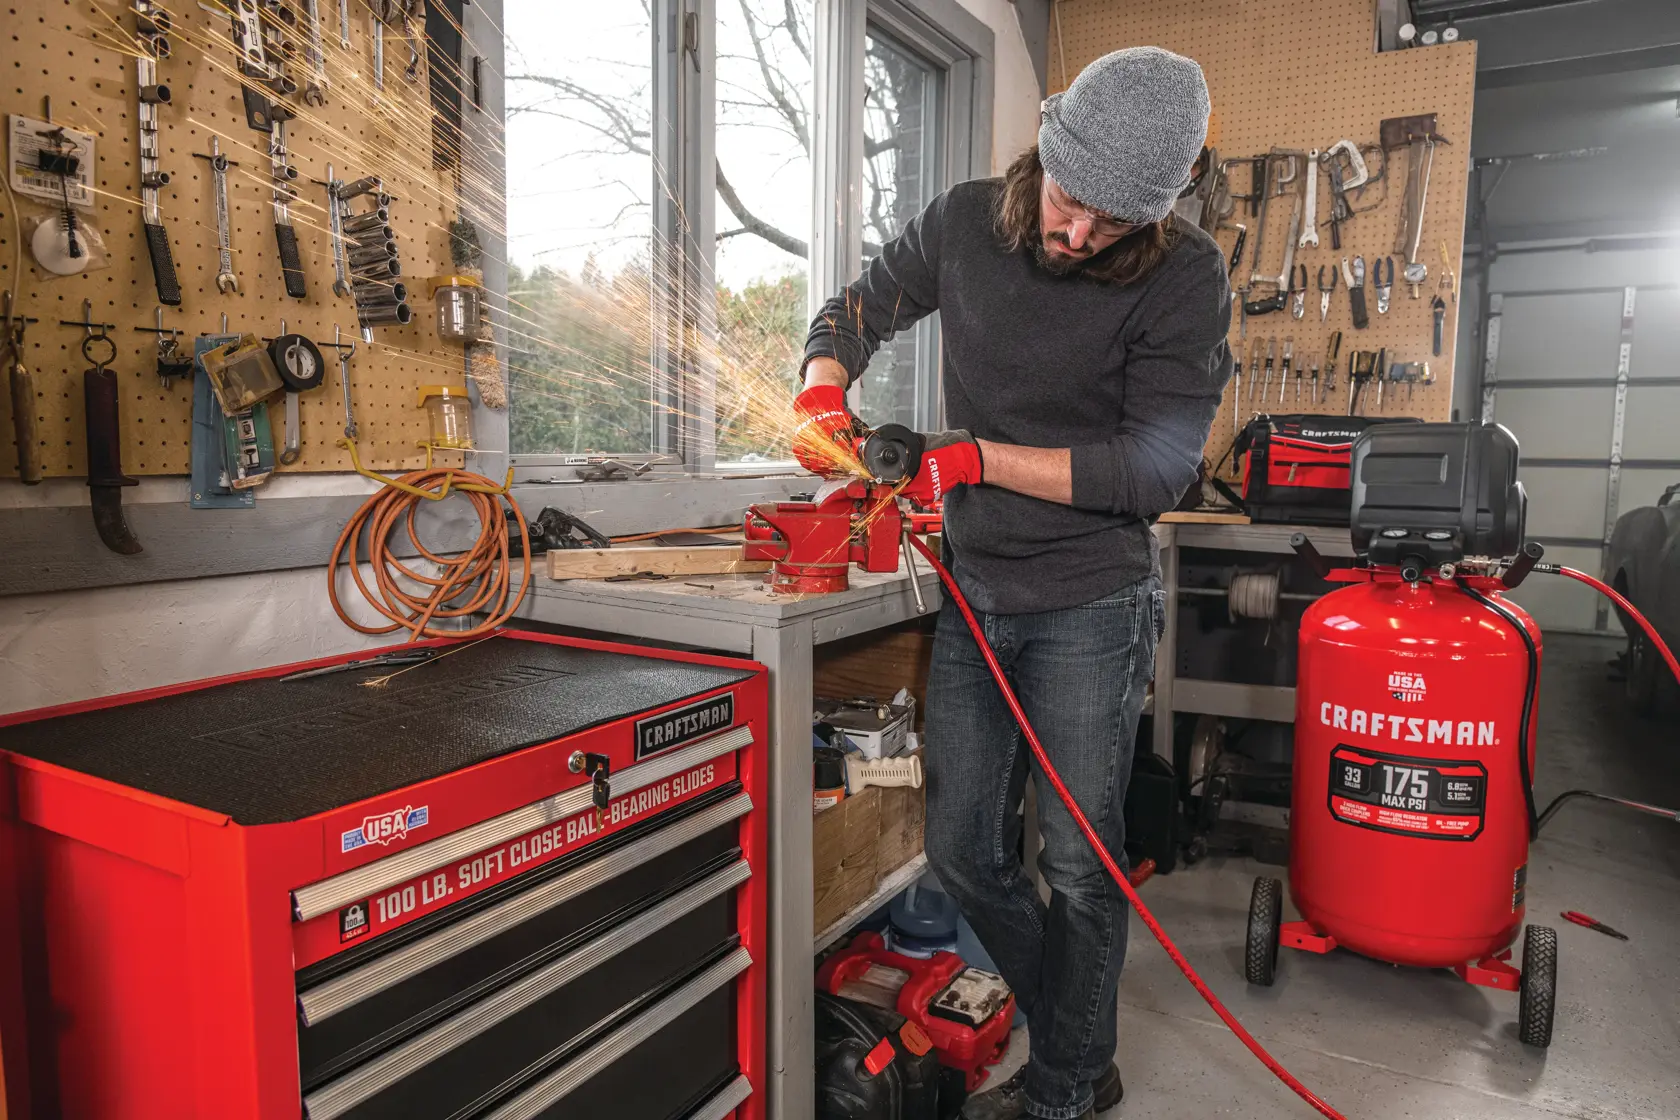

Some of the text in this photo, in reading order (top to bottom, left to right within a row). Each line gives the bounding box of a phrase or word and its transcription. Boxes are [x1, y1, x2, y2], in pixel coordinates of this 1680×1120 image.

[1388, 674, 1427, 690] USA
[645, 702, 729, 748] CRAFTSMAN
[1320, 701, 1496, 746] CRAFTSMAN
[1344, 766, 1361, 784] 33
[1382, 765, 1429, 799] 175
[1381, 793, 1426, 811] MAX PSI
[367, 812, 405, 841] USA
[376, 764, 714, 923] 100 LB. SOFT CLOSE BAL-BEARING SLIDES
[346, 917, 358, 928] 100
